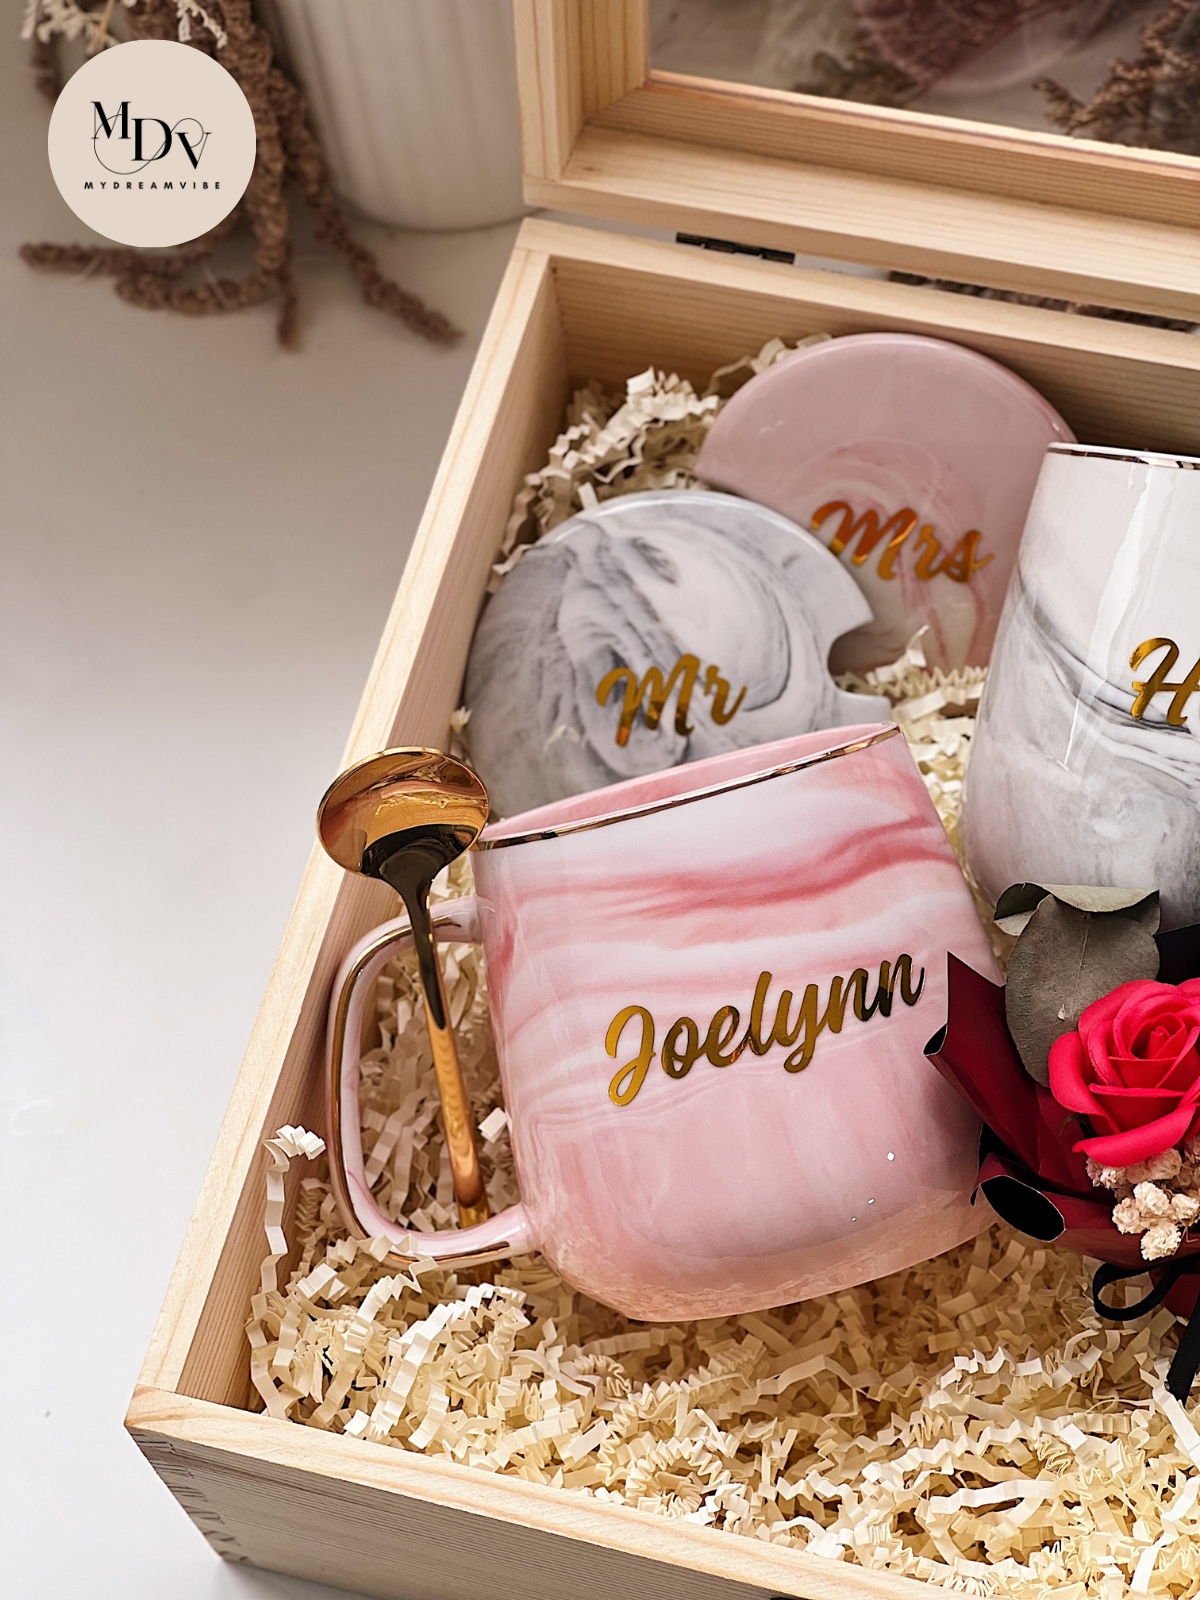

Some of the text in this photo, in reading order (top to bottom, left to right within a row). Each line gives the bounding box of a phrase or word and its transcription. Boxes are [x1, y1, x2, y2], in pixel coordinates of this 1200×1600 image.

[811, 500, 994, 583] Mrs
[596, 653, 747, 748] Mr
[604, 953, 925, 1107] Joelynn
